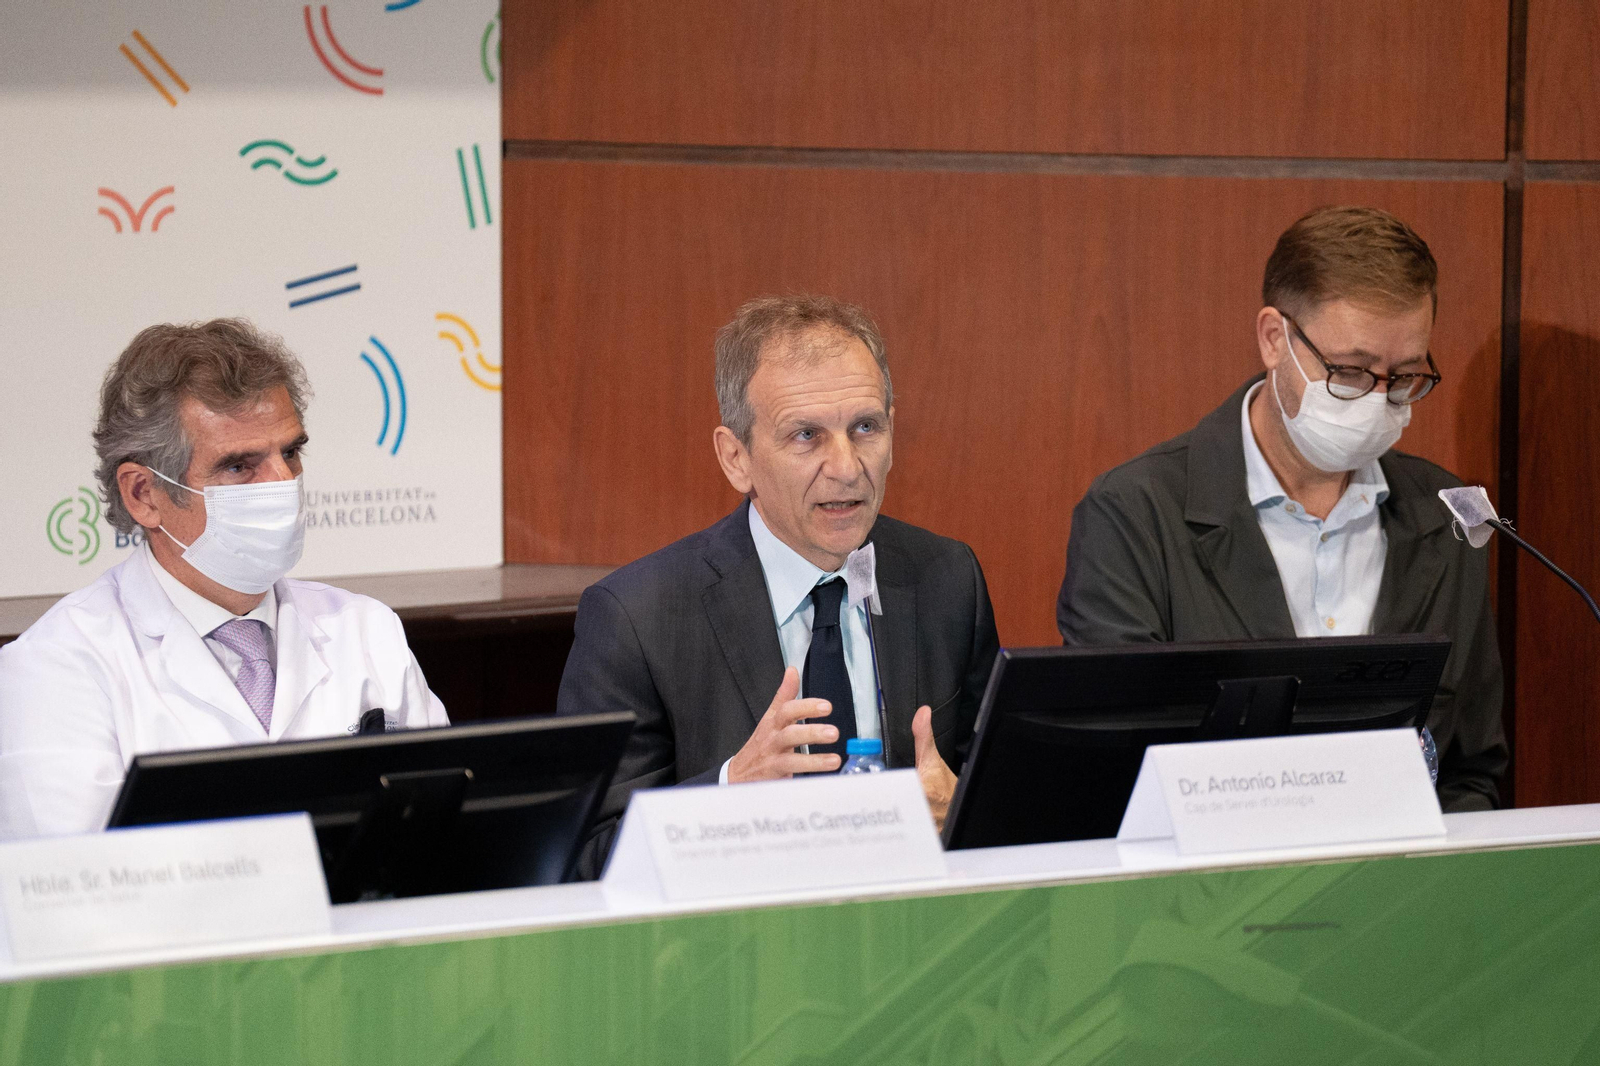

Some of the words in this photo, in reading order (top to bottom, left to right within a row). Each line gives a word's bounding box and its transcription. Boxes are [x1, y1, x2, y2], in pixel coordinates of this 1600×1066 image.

[306, 504, 437, 528] BARCELONA
[1334, 660, 1426, 682] acer
[1178, 777, 1205, 796] Dr.
[1208, 771, 1276, 794] Antonio
[1281, 768, 1347, 788] Alcaraz
[664, 823, 690, 844] Dr.
